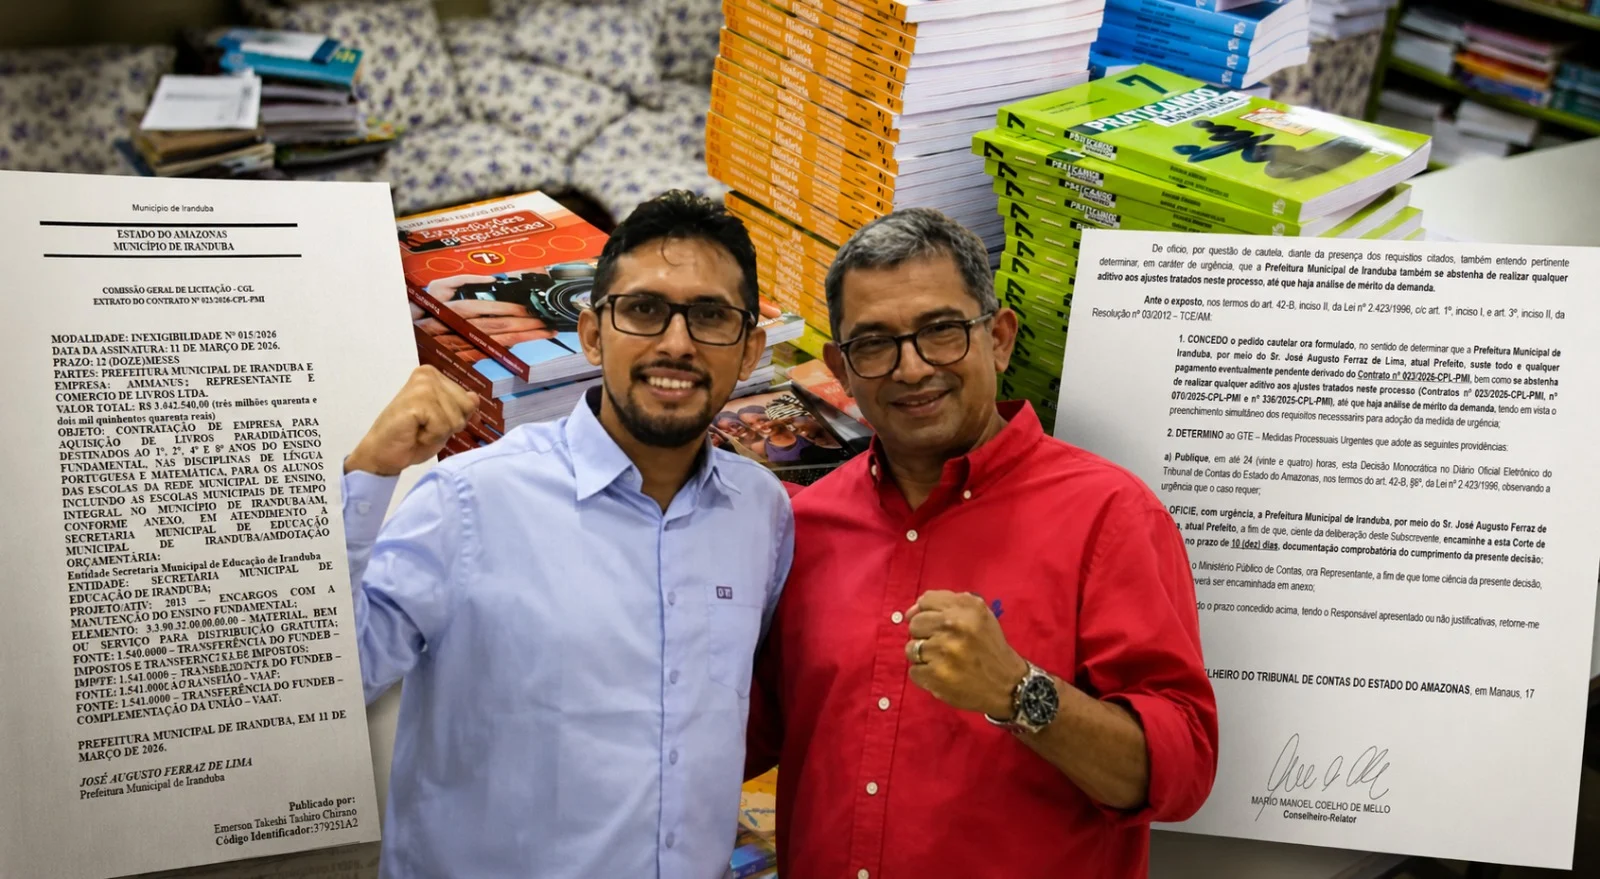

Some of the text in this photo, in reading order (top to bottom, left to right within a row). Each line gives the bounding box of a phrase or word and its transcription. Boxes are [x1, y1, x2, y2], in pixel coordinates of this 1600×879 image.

[1117, 74, 1169, 94] 7
[1084, 88, 1220, 132] PRATICANDO
[1007, 112, 1025, 130] 7
[984, 141, 1004, 158] 7
[998, 162, 1017, 178] 7
[1006, 180, 1024, 197] 7
[169, 204, 180, 212] de
[181, 204, 214, 212] Iranduba
[1010, 202, 1029, 220] 7
[116, 229, 227, 239] ESTADO DO AMAZONAS
[1015, 222, 1034, 239] 7
[113, 240, 235, 251] MUNICÍPIO DE IRANDUBA
[1017, 241, 1036, 257] 7
[1012, 257, 1030, 274] 7
[1098, 257, 1568, 284] determinar, em caráter de urgência, que a Prefeitura Municipal de Iranduba também se abstenha de realizar qualquer
[102, 284, 145, 294] COMISSÃO
[145, 286, 174, 294] GERAL
[175, 285, 187, 293] DE
[187, 283, 232, 294] LICITAÇÃO
[1007, 278, 1026, 296] 7
[50, 333, 128, 343] MODALIDADE:
[130, 331, 222, 342] INEXIGIBILIDADE
[51, 341, 280, 355] DATA DA ASSINATURA: 11 DE MARÇO DE 2026.
[52, 355, 180, 367] PRAZO: 12 (DOZE)MESES
[53, 362, 313, 379] PARTES: PREFEITURA MUNICIPAL DE IRANDUBA E
[55, 388, 208, 402] COMERCIO DE LIVROS LTDA.
[1166, 427, 1174, 437] 2.
[1175, 428, 1224, 439] DETERMINO
[1225, 432, 1235, 440] ao
[1236, 430, 1254, 441] GTE
[1261, 431, 1293, 442] Medidas
[1294, 433, 1339, 444] Processuais
[1340, 435, 1374, 446] Urgentes
[1374, 438, 1389, 447] que
[1390, 437, 1412, 447] adote
[1412, 440, 1422, 448] as
[1423, 440, 1459, 451] seguintes
[1460, 441, 1509, 452] providências:
[1169, 505, 1547, 533] OFICIE, com urgência, a Prefeitura Municipal de Iranduba, por meio do Sr. José Augusto Ferraz de
[64, 516, 329, 543] SECRETARIA MUNICIPAL DE EDUCAÇÃO
[1241, 670, 1255, 681] DO
[1256, 671, 1299, 684] TRIBUNAL
[1301, 673, 1314, 685] DE
[1315, 675, 1351, 687] CONTAS
[1352, 677, 1366, 688] DO
[1367, 678, 1403, 690] ESTADO
[1405, 680, 1419, 691] DO
[1419, 681, 1472, 696] AMAZONAS,
[1474, 687, 1487, 695] em
[1488, 686, 1522, 698] Manaus,
[1525, 688, 1535, 698] 17
[77, 709, 346, 750] PREFEITURA MUNICIPAL DE IRANDUBA, EM 11 DE
[78, 743, 167, 762] MARÇO DE 2026.
[79, 757, 252, 787] JOSÉ AUGUSTO FERRAZ DE LIMA
[79, 773, 225, 800] Prefeitura Municipal de Iranduba
[288, 796, 355, 811] Publicado por:
[1250, 795, 1391, 814] MARIO MANOEL COELHO DE MELLO
[213, 808, 357, 834] Emerson Takeshi Tashiro Chirano
[1282, 809, 1357, 823] Conselheiro-Relator
[215, 834, 249, 846] Código
